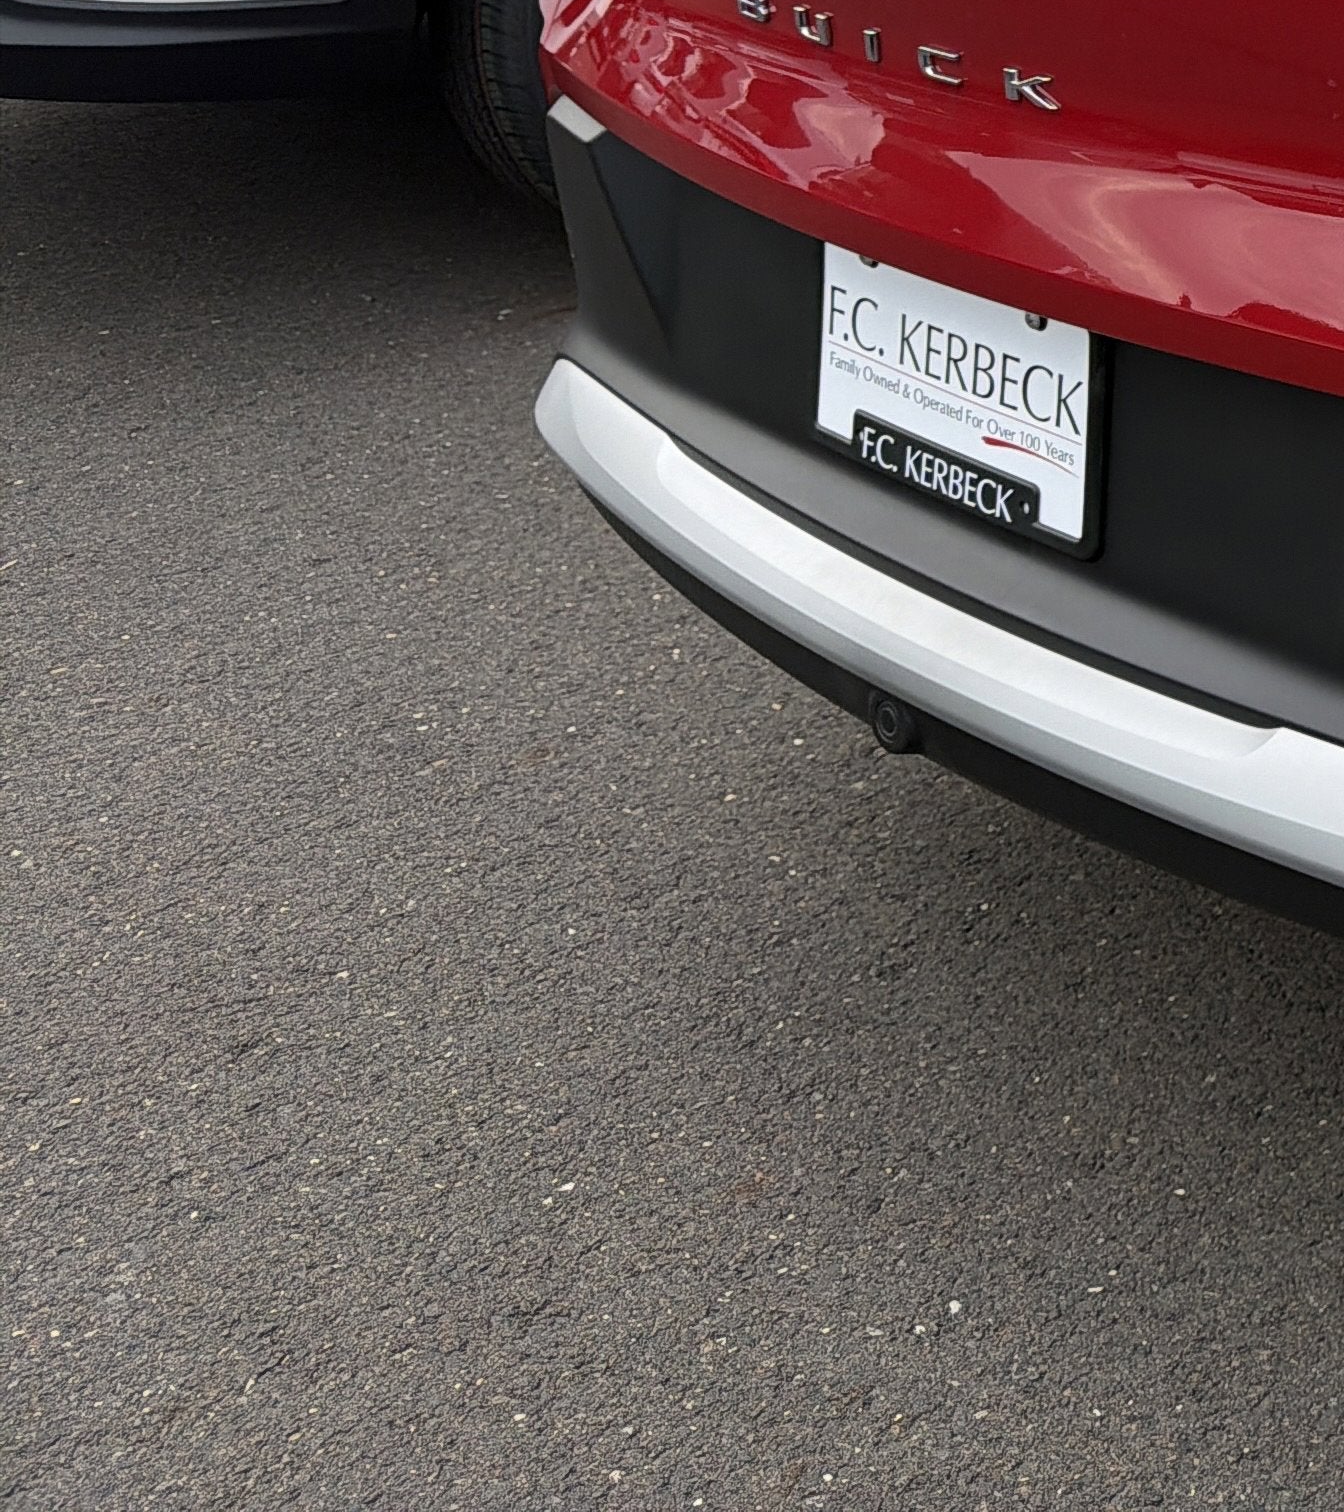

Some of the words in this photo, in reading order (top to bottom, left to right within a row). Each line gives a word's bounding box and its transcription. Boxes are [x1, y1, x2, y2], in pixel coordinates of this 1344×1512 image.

[828, 284, 884, 358] F.C.
[899, 313, 1084, 437] KERBECK
[829, 351, 862, 381] Family
[863, 365, 901, 395] Owned
[902, 383, 912, 401] &
[913, 387, 964, 422] Operated
[965, 409, 985, 430] For
[987, 418, 1017, 442] Over
[1020, 430, 1041, 452] 100
[1045, 439, 1076, 467] Years
[861, 426, 898, 474] F.C.
[904, 445, 1015, 524] KERBECK
